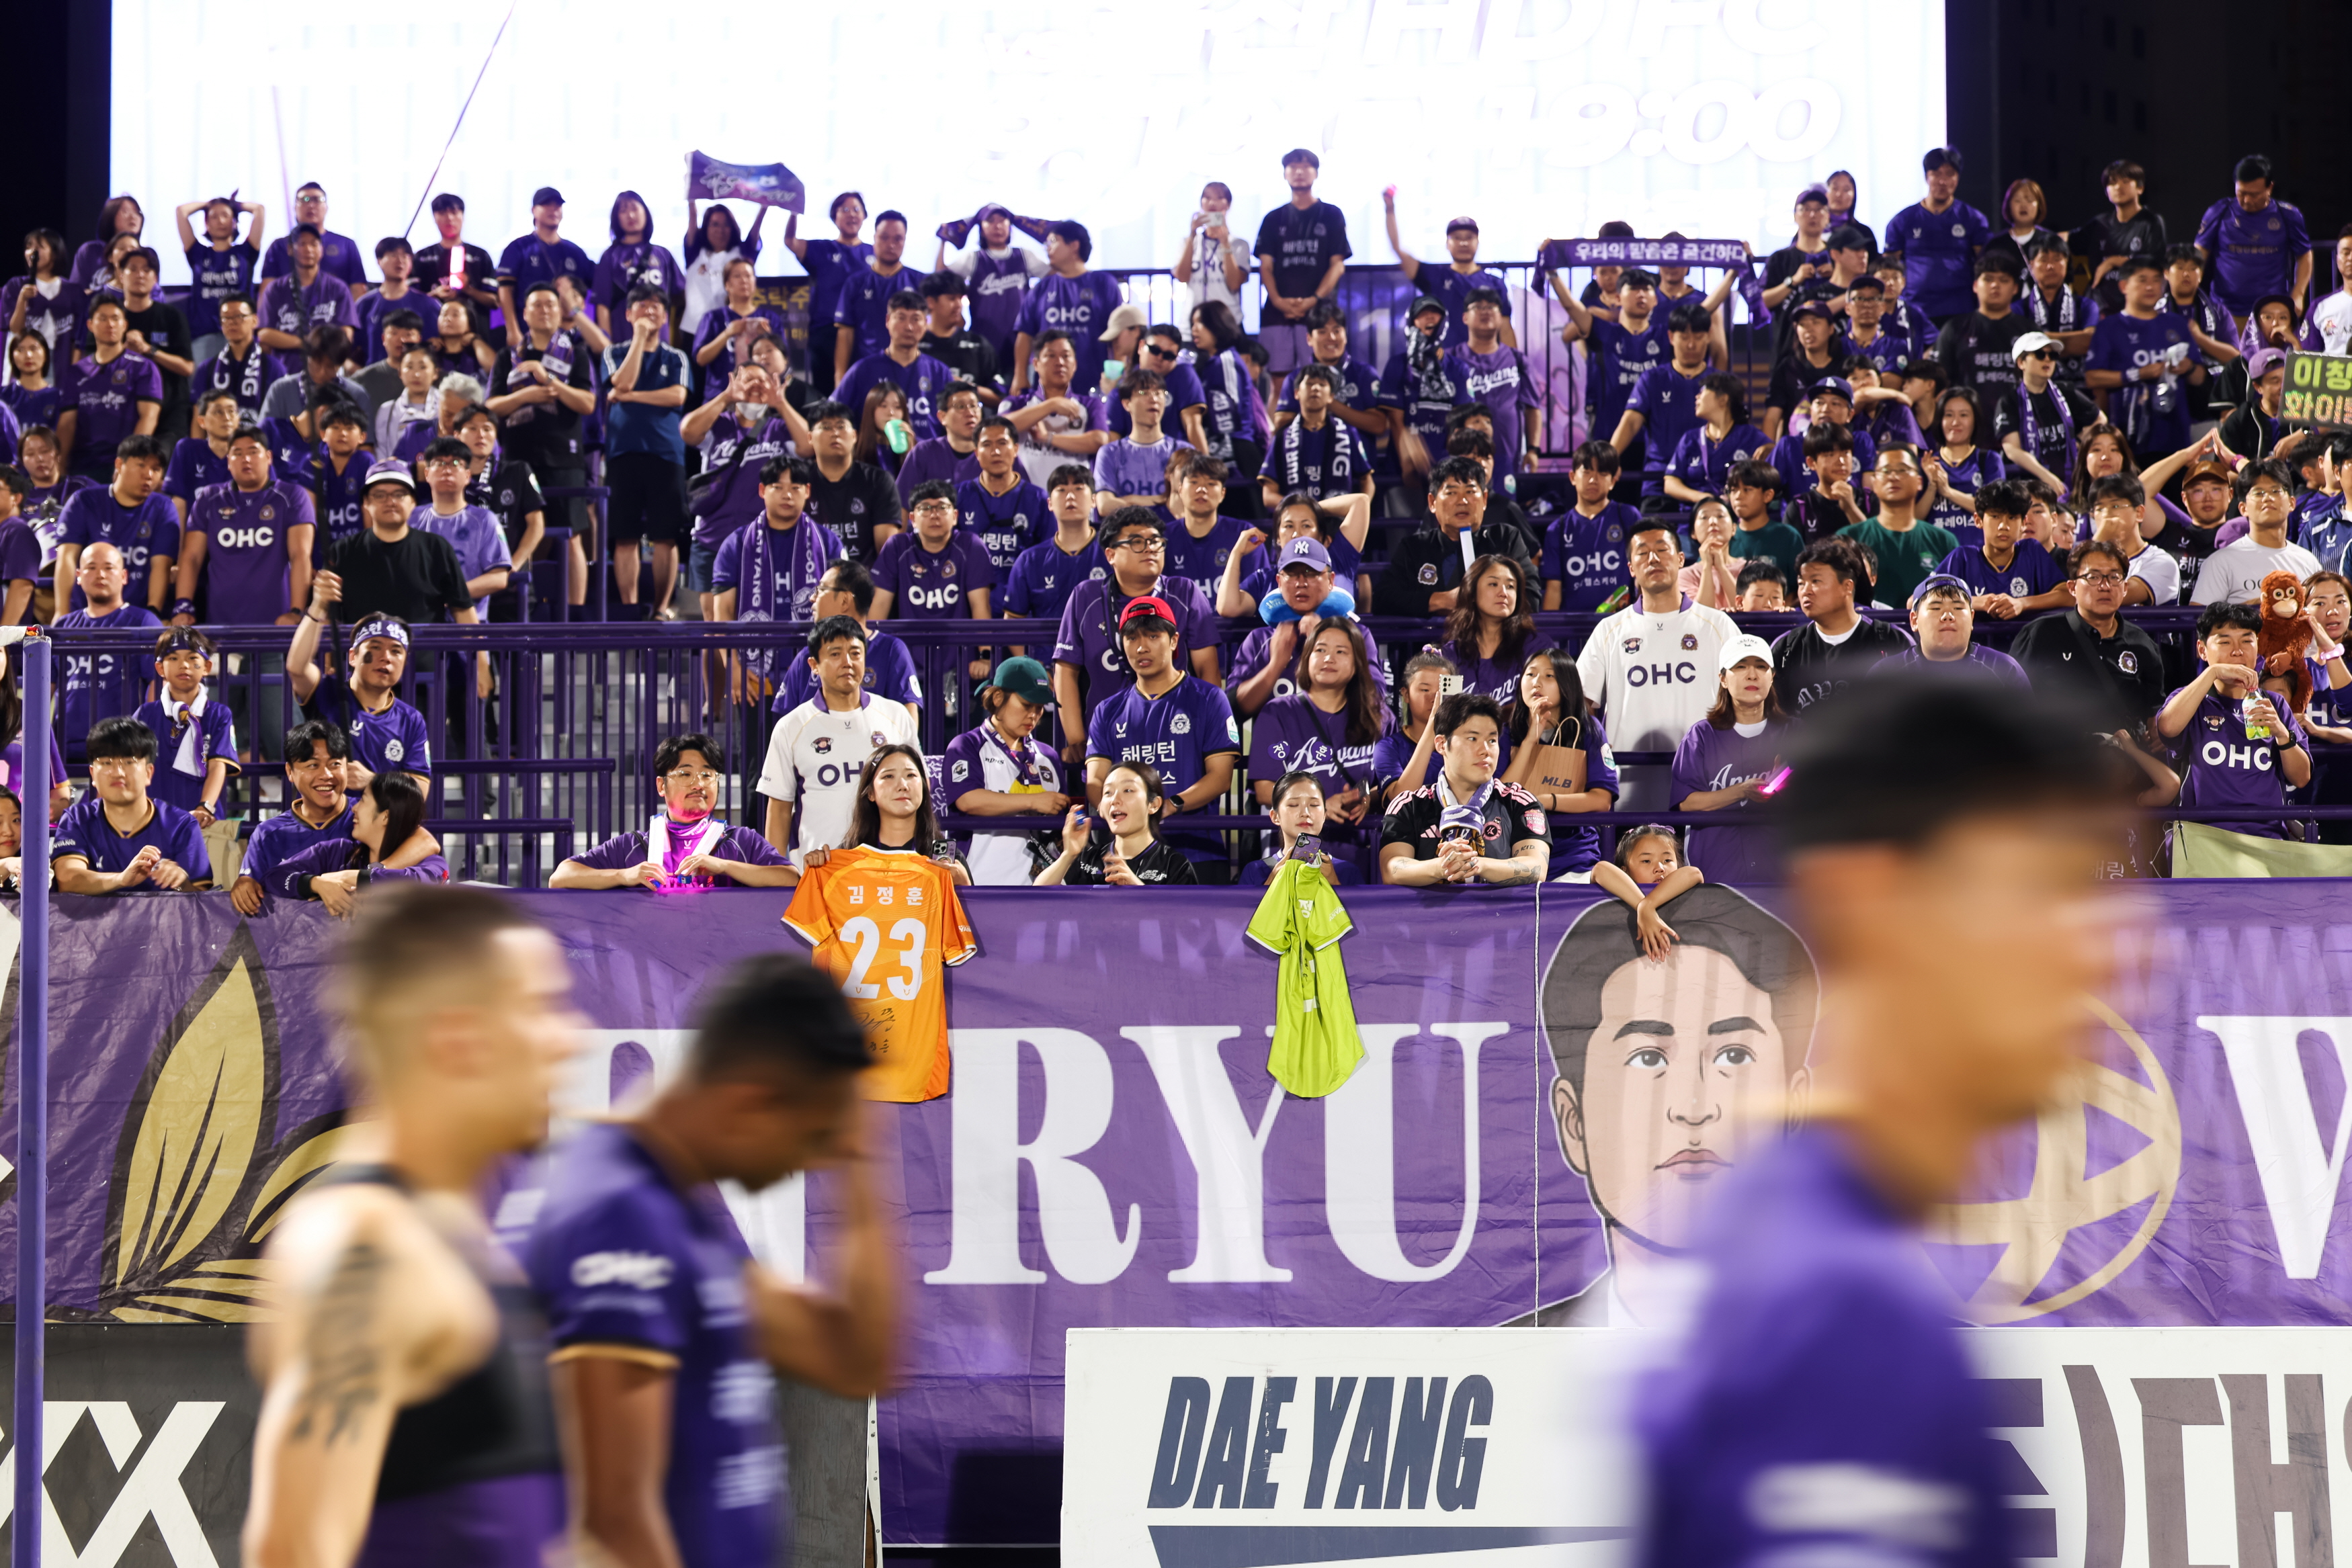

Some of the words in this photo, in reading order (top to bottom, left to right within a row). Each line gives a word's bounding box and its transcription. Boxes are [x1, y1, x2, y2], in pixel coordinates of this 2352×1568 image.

[1574, 243, 1625, 261] 우리의
[1629, 243, 1679, 260] 믿음은
[1046, 306, 1091, 323] OHC
[2133, 349, 2166, 367] OH
[329, 503, 360, 526] HC
[218, 526, 274, 548] OHC
[116, 546, 149, 566] HC
[991, 555, 1015, 568] 이스
[1566, 550, 1620, 576] OHC
[909, 583, 959, 609] OHC
[1627, 662, 1696, 687] OHC
[2306, 702, 2352, 725] HC
[1121, 740, 1177, 765] 해링턴
[1289, 736, 1376, 777] Ayang
[2201, 740, 2273, 771] OHC
[816, 764, 864, 787] OH
[1541, 775, 1572, 788] MLB
[53, 839, 76, 848] NYANG
[1329, 906, 1345, 922] ANYA
[839, 916, 927, 1001] 23
[924, 1022, 1510, 1285] RYU
[1146, 1376, 1297, 1510] DAE
[1303, 1373, 1495, 1512] YANG
